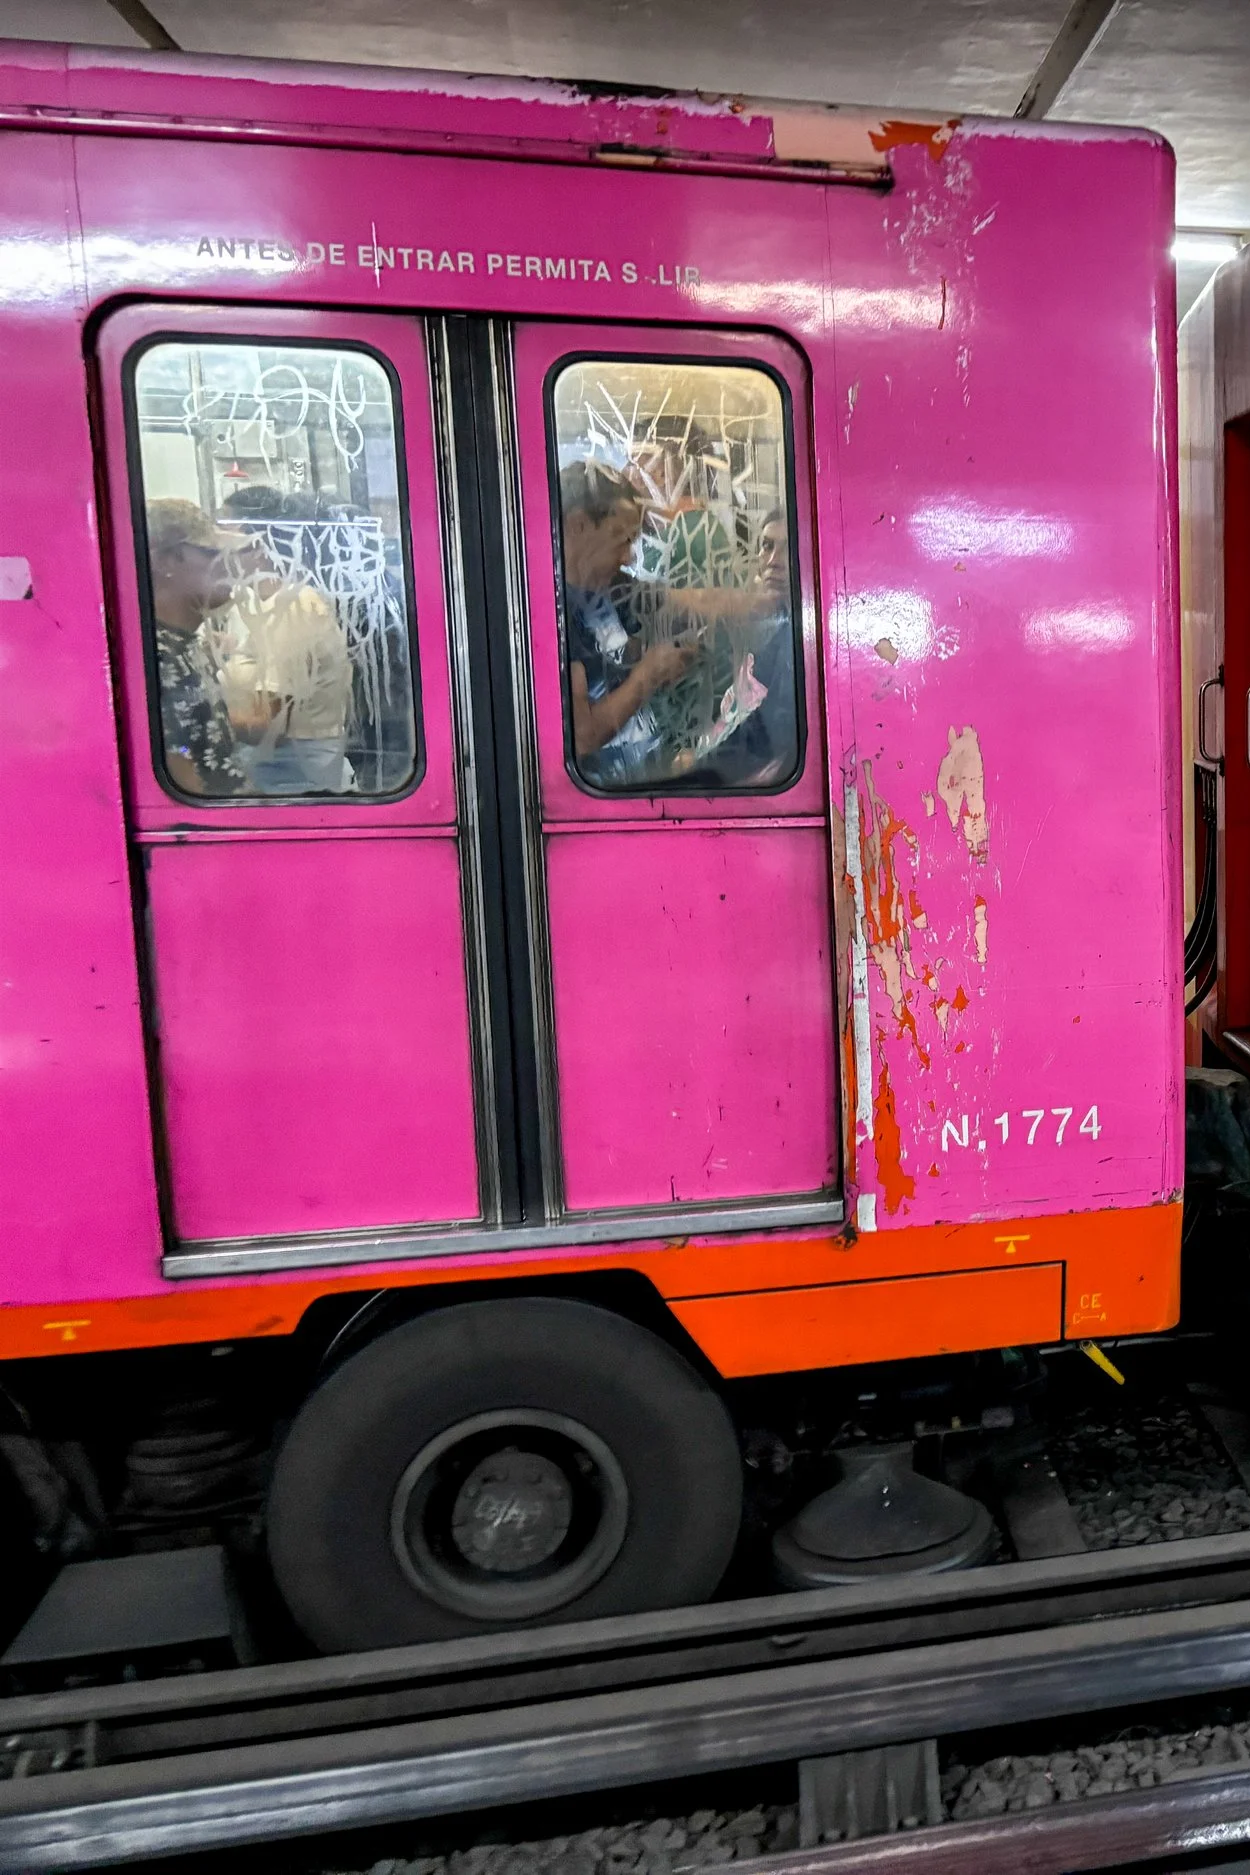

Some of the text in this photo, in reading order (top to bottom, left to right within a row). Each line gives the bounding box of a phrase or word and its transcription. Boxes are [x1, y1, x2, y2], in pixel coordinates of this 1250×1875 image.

[196, 236, 700, 286] ANTES DE ENTRAR PERMITA SLIR
[1080, 1293, 1102, 1309] CE
